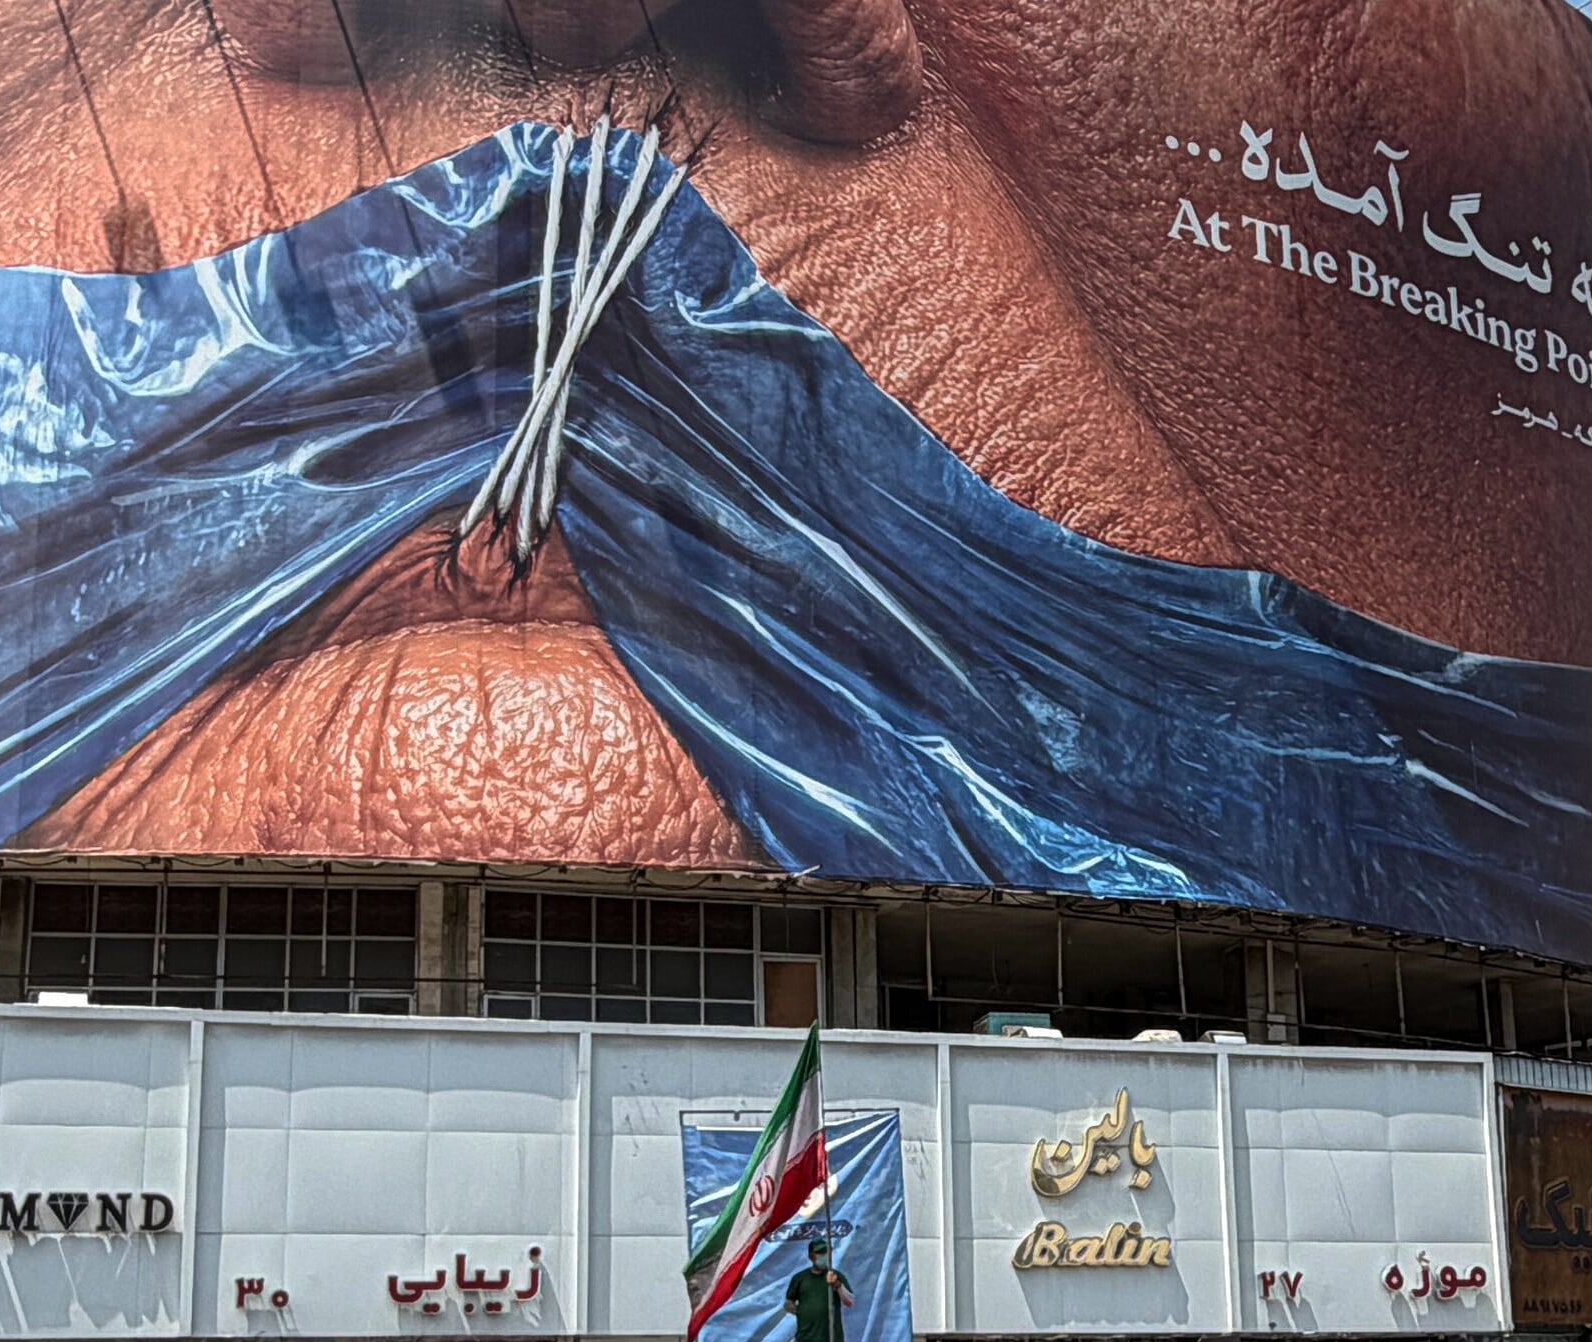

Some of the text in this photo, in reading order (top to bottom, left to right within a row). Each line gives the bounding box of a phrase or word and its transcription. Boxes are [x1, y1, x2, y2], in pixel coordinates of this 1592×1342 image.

[1166, 198, 1232, 253] At
[1241, 215, 1338, 284] The
[1347, 250, 1539, 373] Breaking
[1422, 192, 1552, 294] تنگ
[1029, 1086, 1158, 1198] بالین
[387, 1245, 542, 1315] زیبایی
[1012, 1220, 1172, 1269] Balin
[1383, 1250, 1487, 1299] موزه
